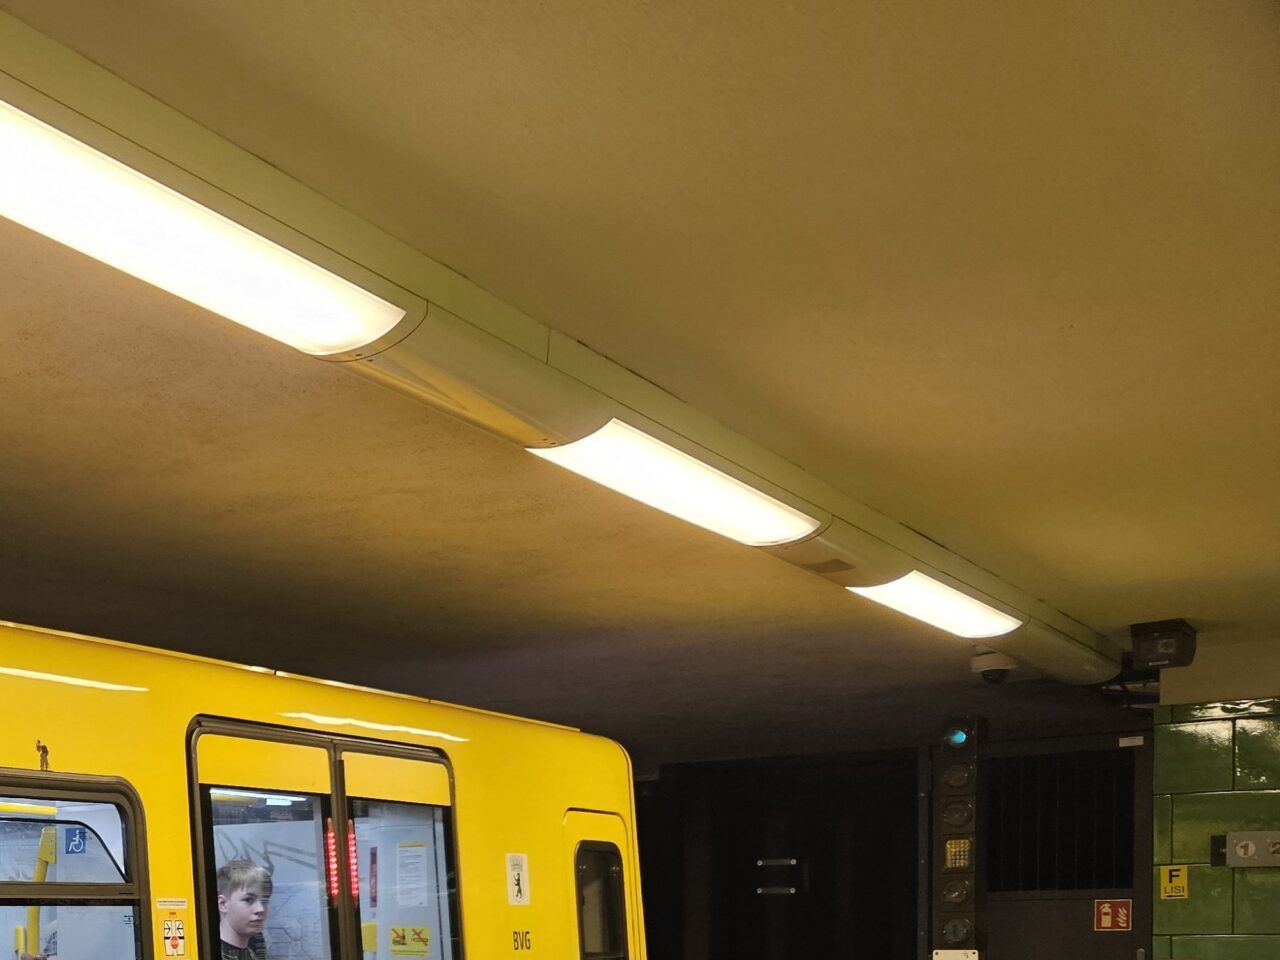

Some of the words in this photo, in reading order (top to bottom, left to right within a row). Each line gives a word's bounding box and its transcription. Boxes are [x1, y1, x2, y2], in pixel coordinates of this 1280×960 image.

[1239, 842, 1250, 856] 1
[1168, 868, 1181, 884] F
[512, 931, 531, 951] BVG
